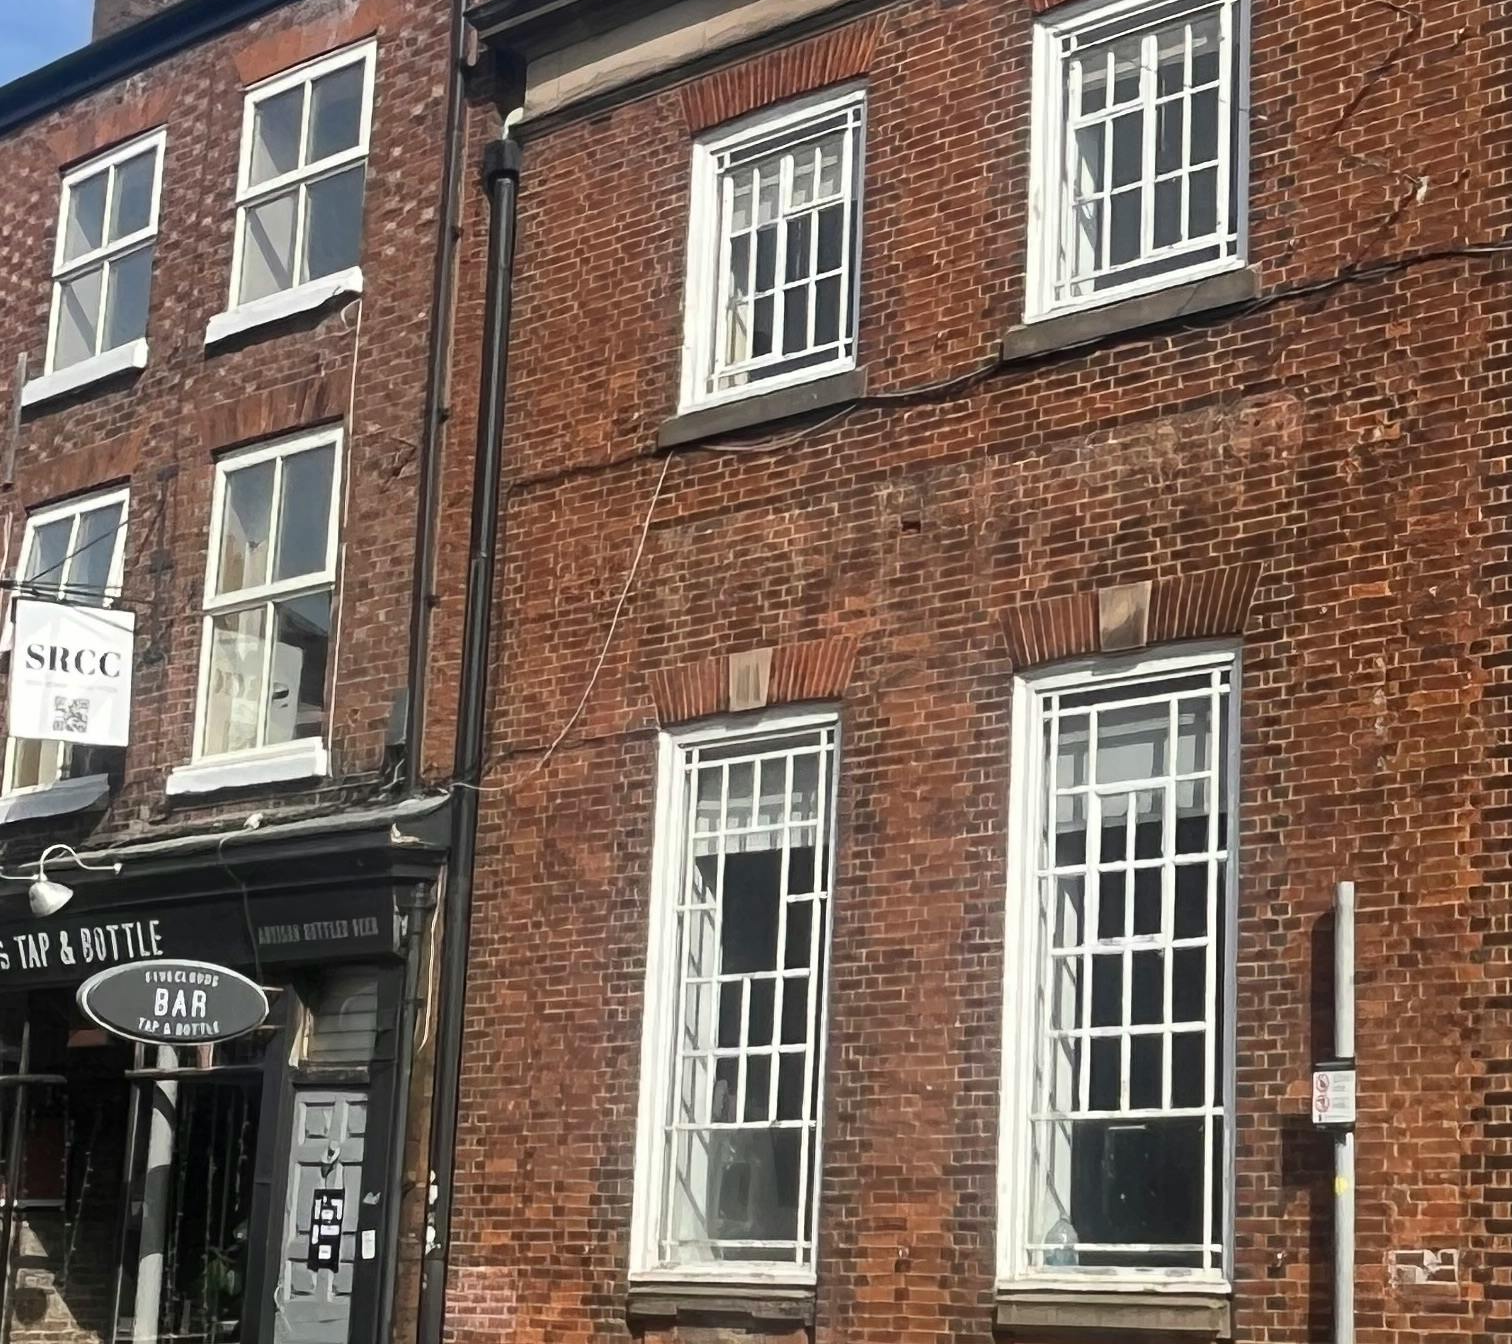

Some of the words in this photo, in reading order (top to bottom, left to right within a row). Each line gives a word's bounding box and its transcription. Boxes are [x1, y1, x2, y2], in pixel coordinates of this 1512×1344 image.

[25, 643, 122, 678] SRCC
[13, 932, 50, 969] TAP
[59, 930, 77, 964] &
[80, 920, 164, 963] BOTTLE
[154, 988, 207, 1018] BAR
[138, 1017, 160, 1033] TAP
[175, 1020, 220, 1036] BOTTLE
